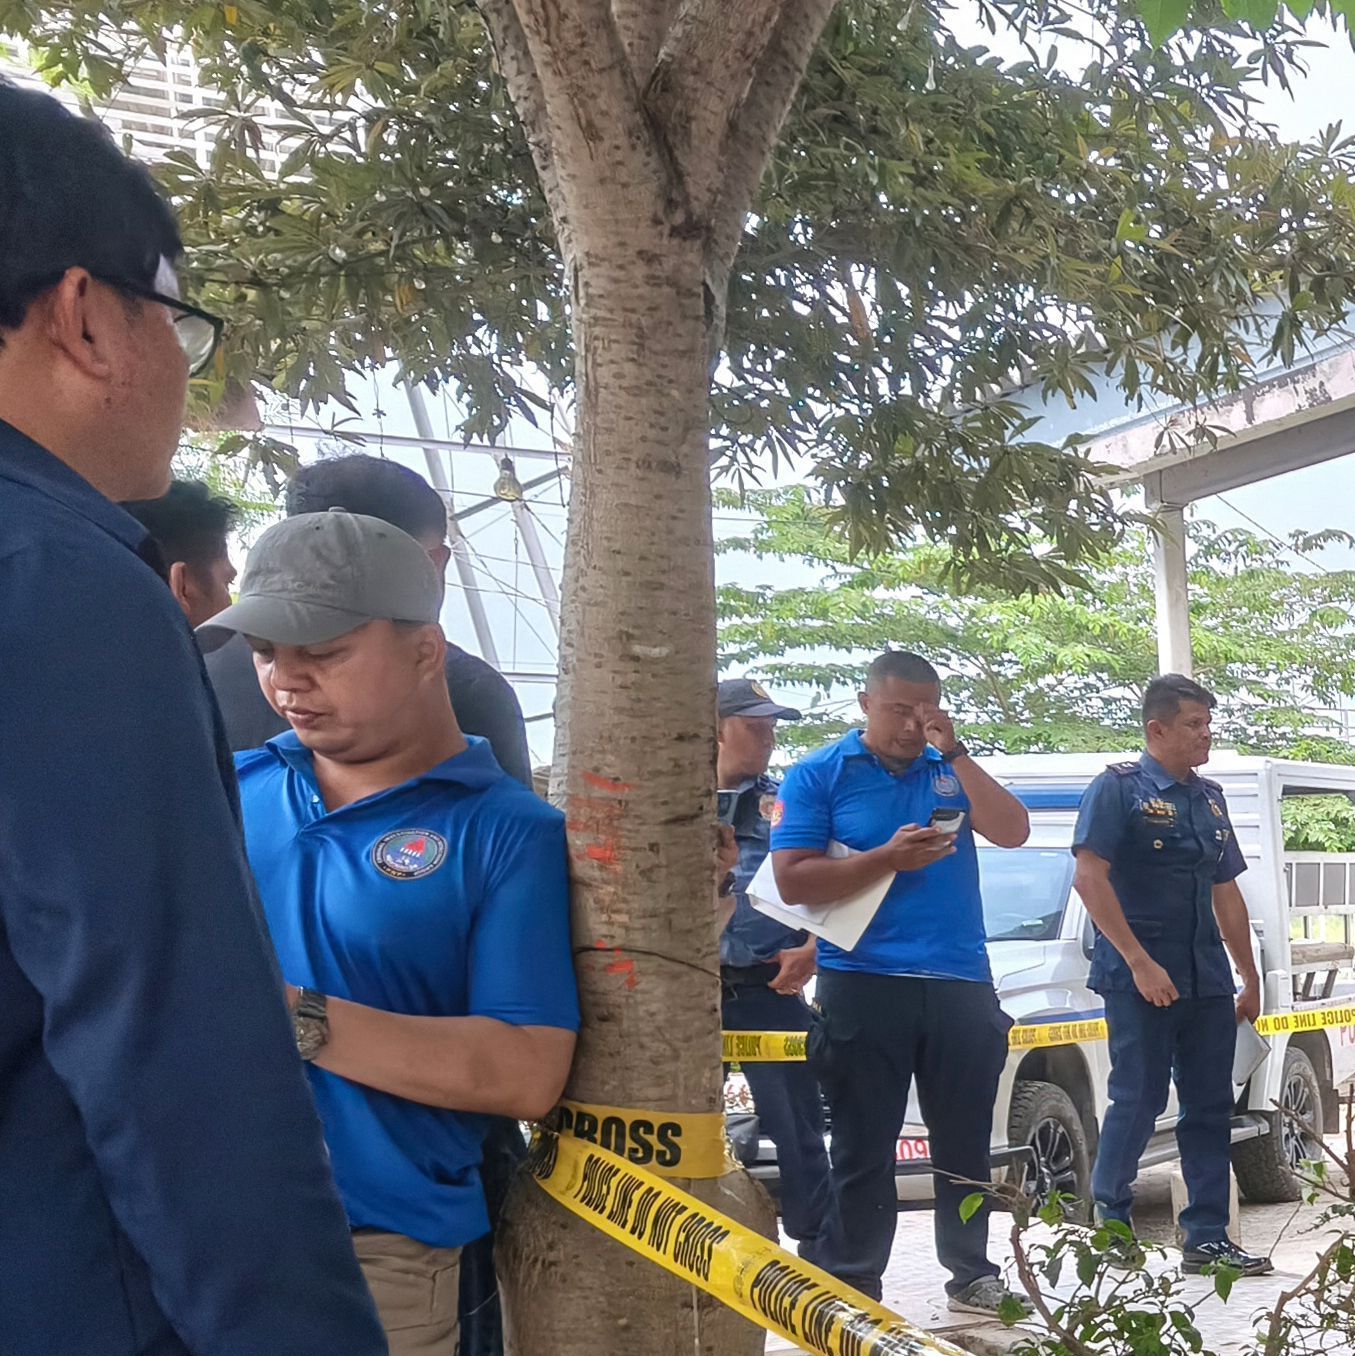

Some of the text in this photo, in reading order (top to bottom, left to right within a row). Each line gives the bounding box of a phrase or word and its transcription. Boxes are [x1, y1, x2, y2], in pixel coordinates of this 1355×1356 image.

[573, 1153, 621, 1215] POLICE
[606, 1172, 644, 1230] LINE
[633, 1185, 663, 1239] DO
[647, 1194, 688, 1256] NOT
[673, 1211, 731, 1282] CROSS
[750, 1259, 819, 1336] POLICE
